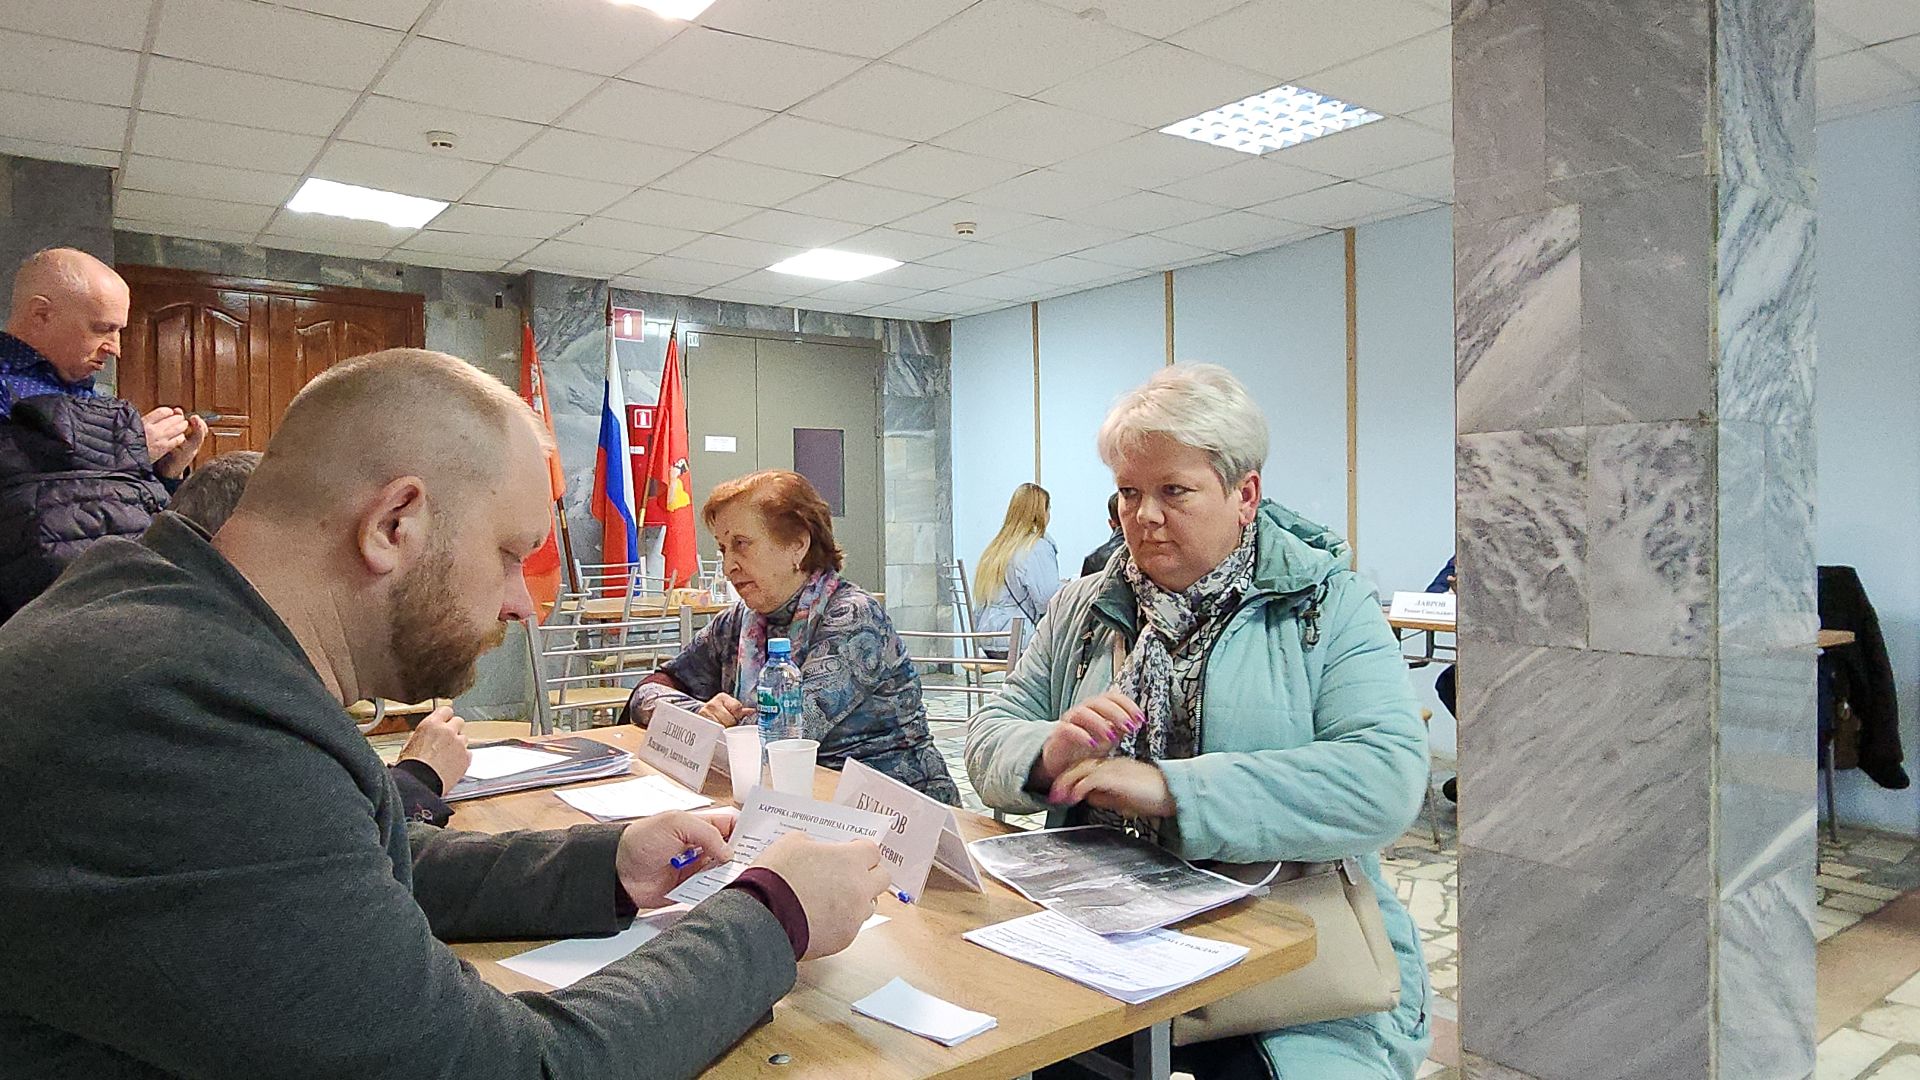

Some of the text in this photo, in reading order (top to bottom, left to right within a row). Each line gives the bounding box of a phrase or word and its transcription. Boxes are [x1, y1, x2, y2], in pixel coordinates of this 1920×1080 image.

[663, 721, 697, 747] ДЕНИСОВ
[758, 803, 790, 817] КАРТОЧКА
[789, 811, 819, 824] ЛИЧНОГО
[819, 816, 845, 830] ПРИЕМА
[845, 824, 877, 837] ГРАЖДАН
[879, 842, 904, 867] геевич
